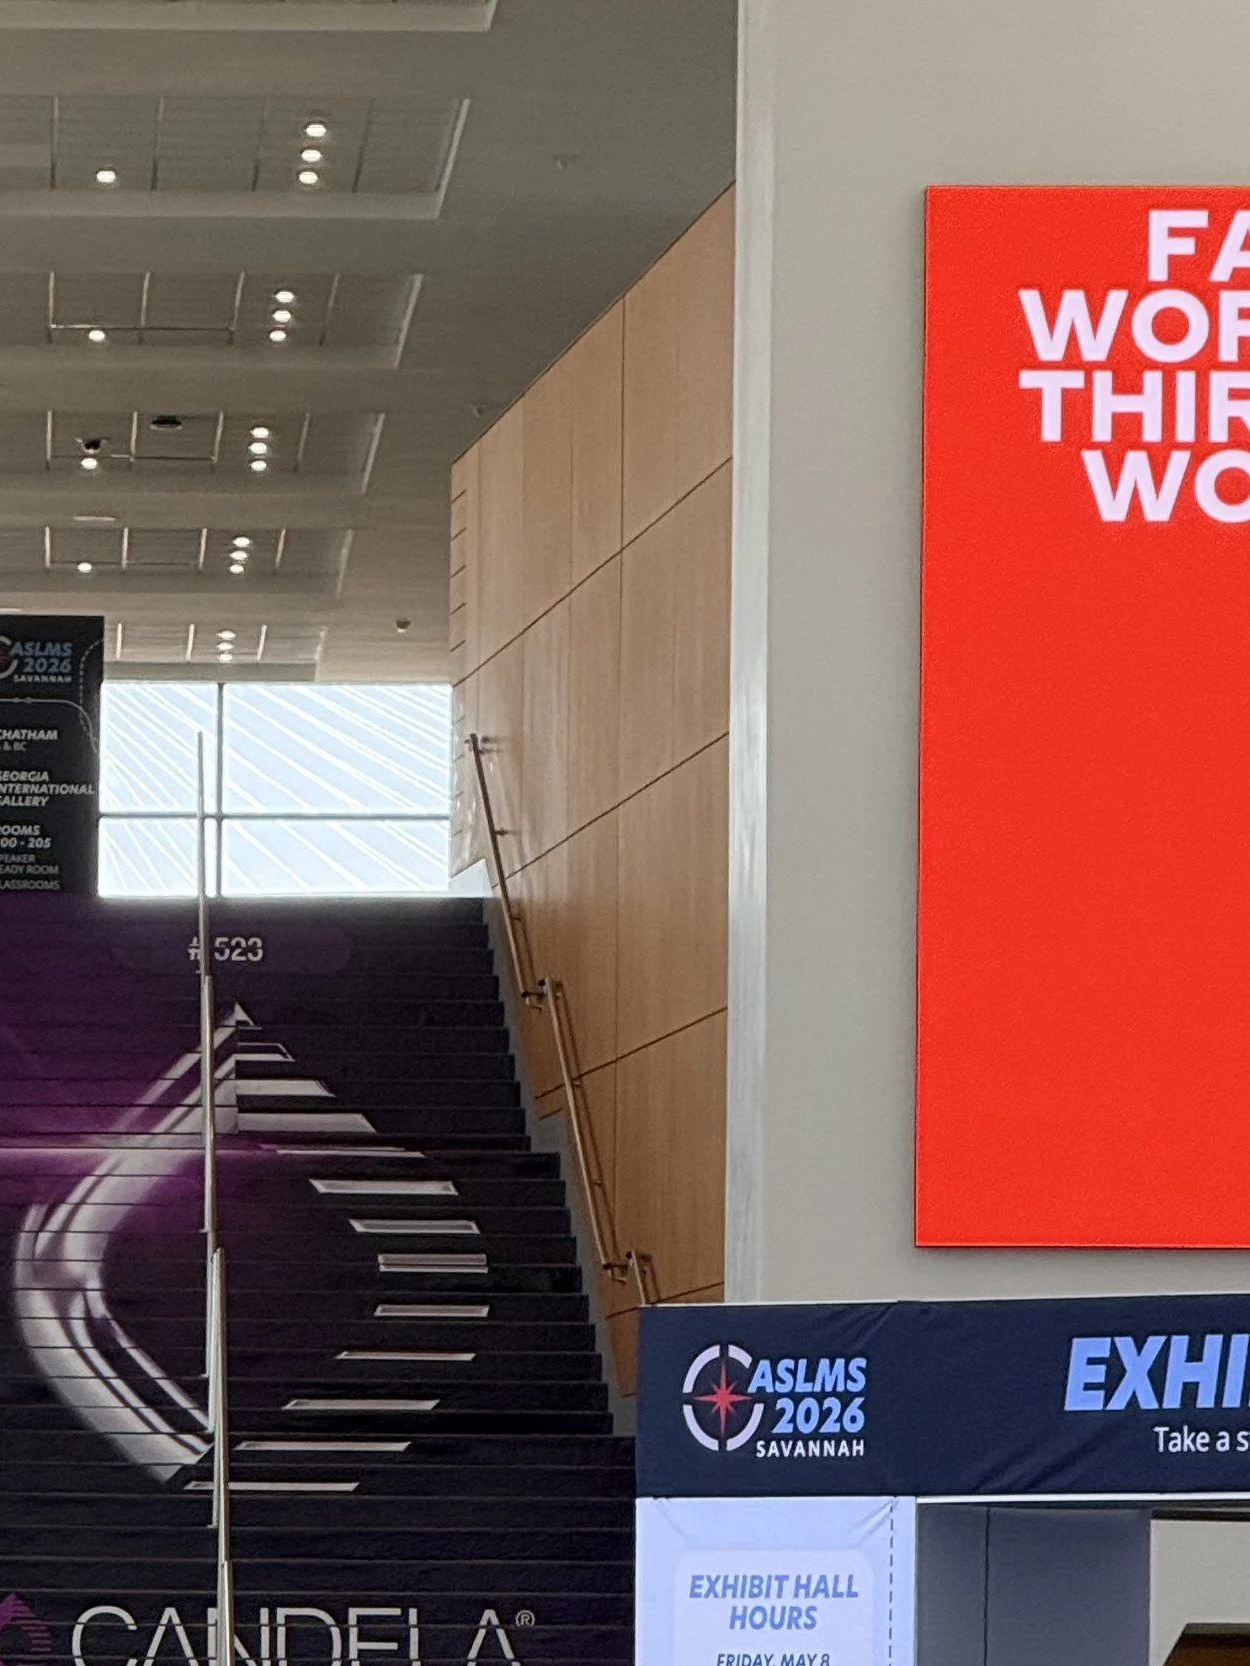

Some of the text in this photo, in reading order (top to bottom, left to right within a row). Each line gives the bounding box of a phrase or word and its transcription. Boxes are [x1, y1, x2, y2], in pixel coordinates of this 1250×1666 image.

[10, 642, 73, 656] ASLMS
[23, 658, 72, 673] 2026
[14, 675, 72, 683] SAVANNAH
[2, 742, 10, 751] &
[27, 837, 52, 848] 205
[26, 865, 60, 874] ROOM
[747, 1357, 868, 1393] ASLMS
[1064, 1333, 1250, 1411] EXHI
[771, 1397, 866, 1434] 2026
[1153, 1425, 1250, 1453] Take a s
[755, 1440, 865, 1458] SAVANNAH
[689, 1574, 859, 1599] EXHIBIT HALL
[729, 1605, 818, 1630] HOURS
